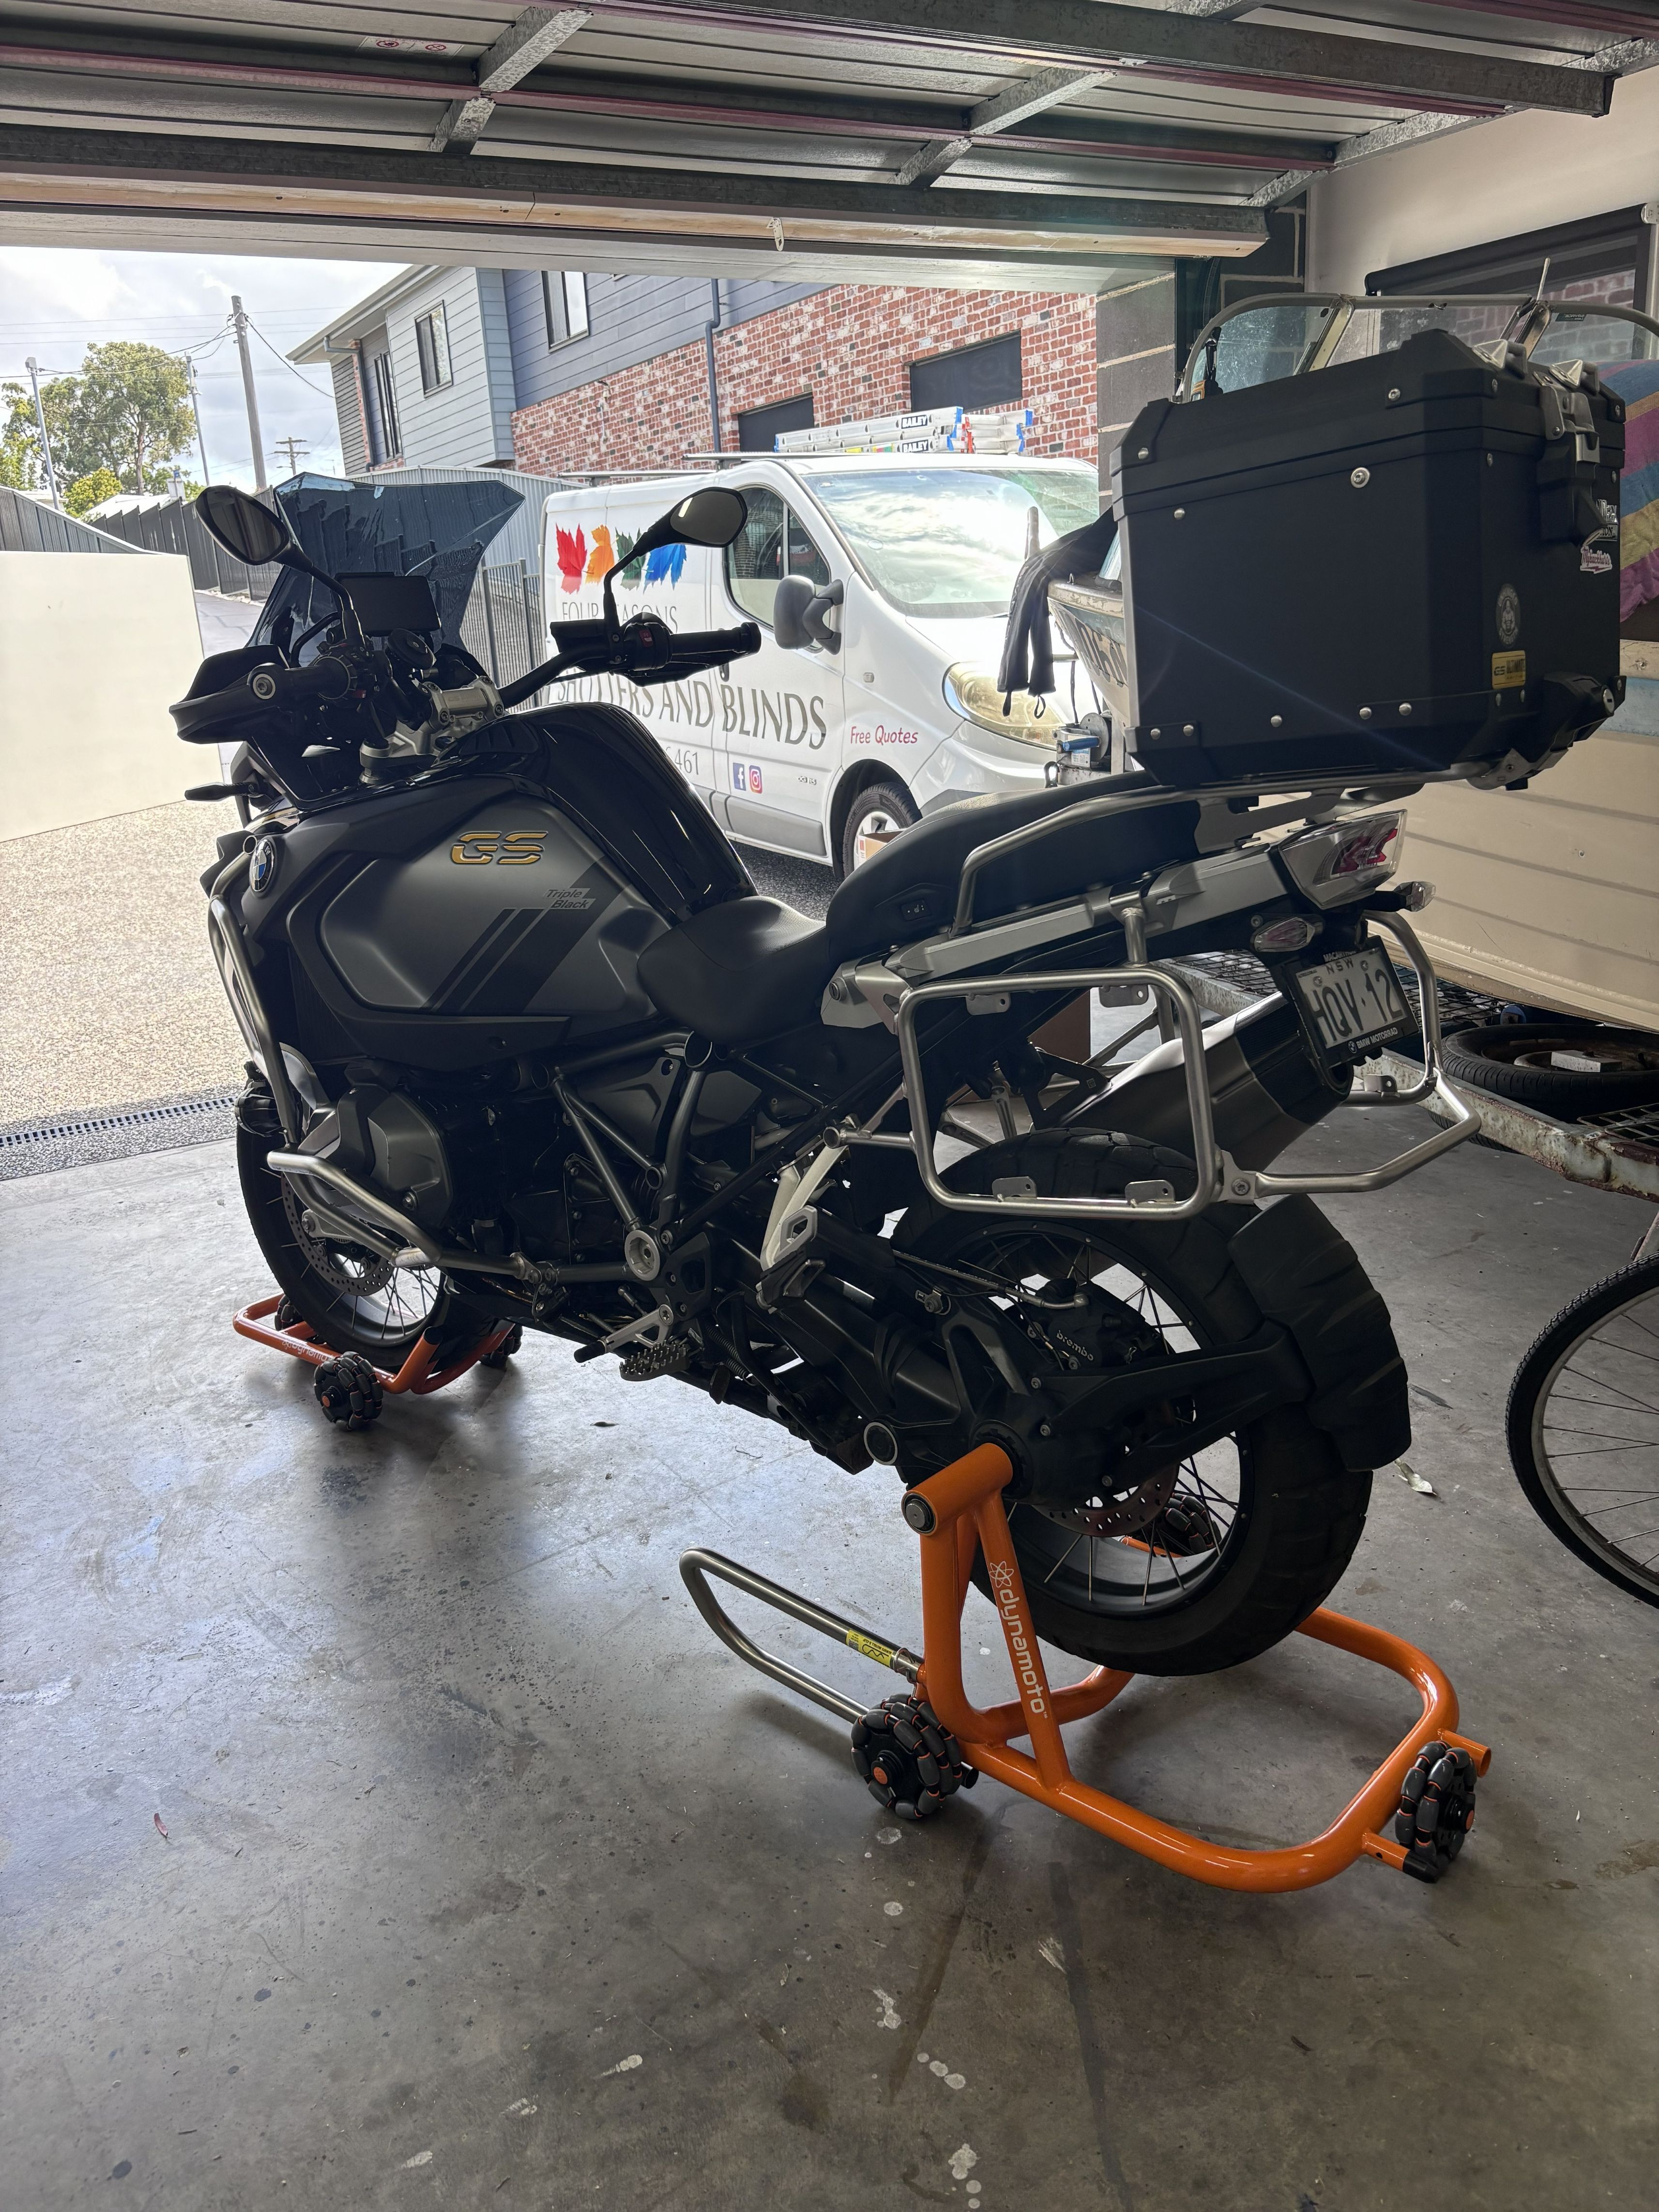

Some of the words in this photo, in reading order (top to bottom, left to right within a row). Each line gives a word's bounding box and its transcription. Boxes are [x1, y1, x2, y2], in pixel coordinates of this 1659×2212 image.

[902, 415, 927, 429] BAILEY
[903, 440, 928, 453] BAILEY
[659, 680, 714, 727] AND
[720, 684, 826, 750] BLINDS
[850, 726, 870, 744] Free
[875, 725, 918, 746] Quotes
[451, 831, 548, 865] GS
[546, 889, 582, 899] Triple
[551, 900, 589, 909] Black
[1325, 957, 1354, 975] NSW
[1356, 1037, 1371, 1049] BMW
[1370, 1027, 1398, 1044] MOTORRAD
[1056, 1329, 1094, 1361] brembo
[999, 1588, 1045, 1714] dynamoto
